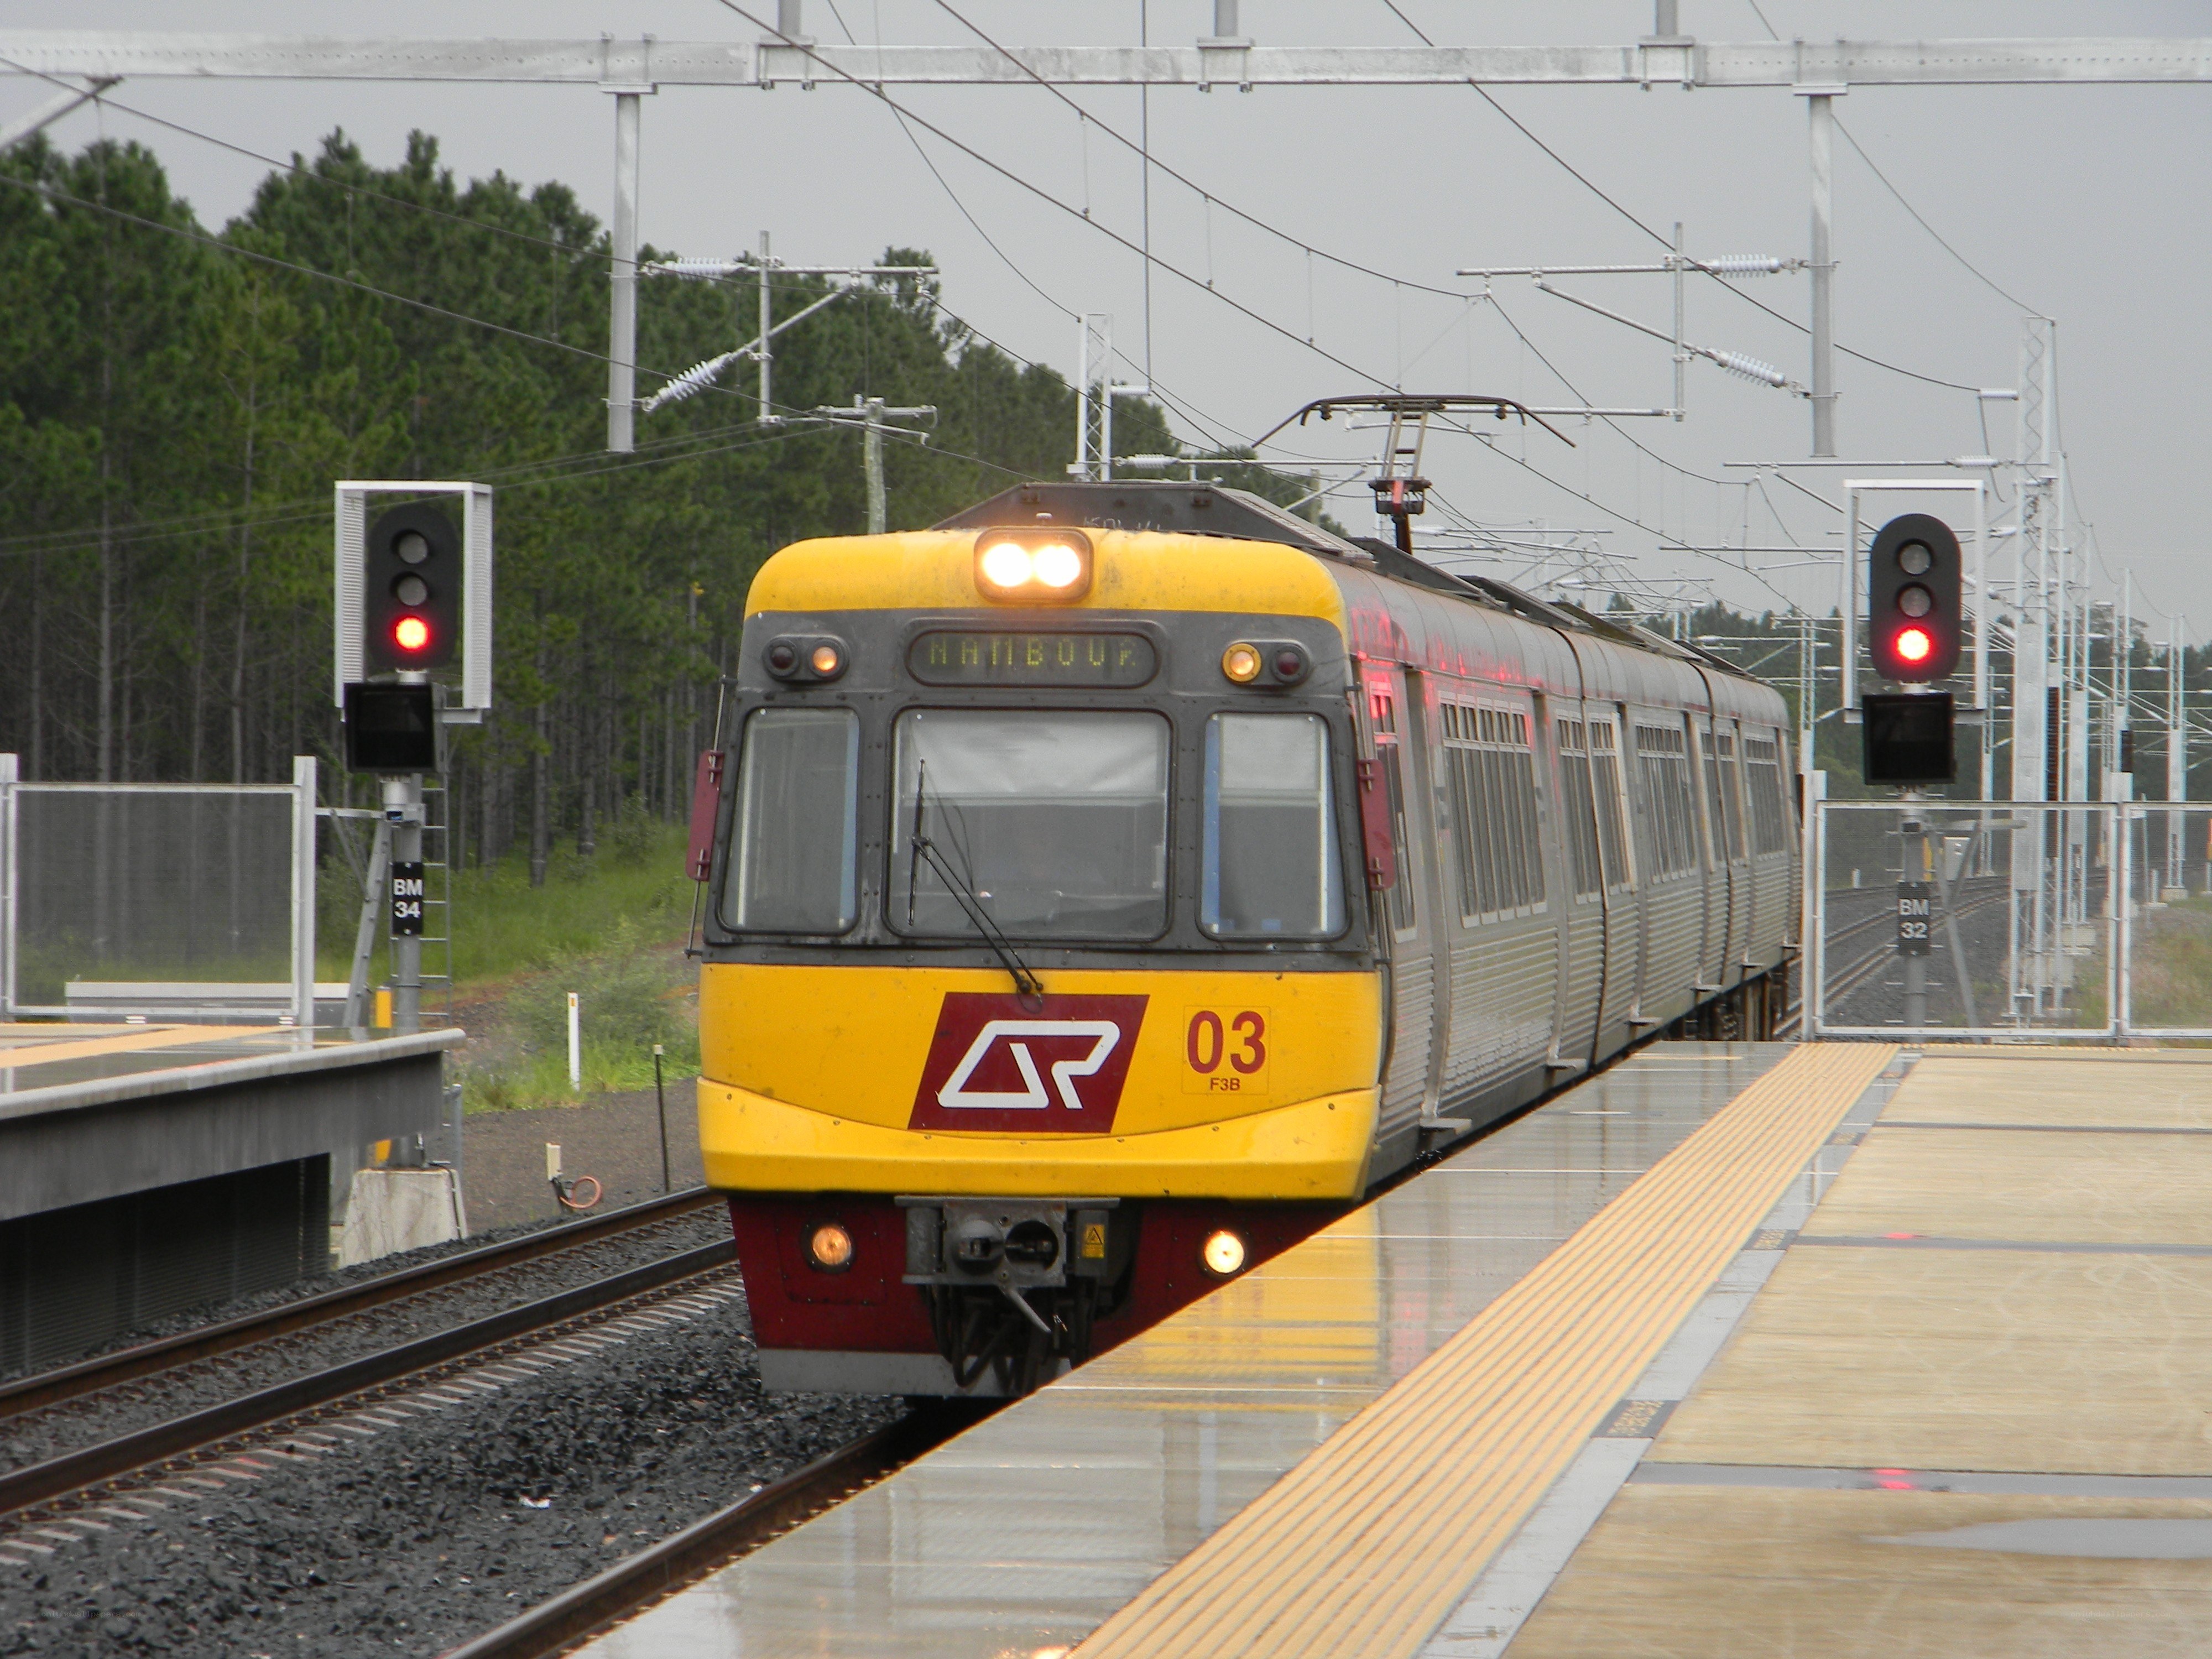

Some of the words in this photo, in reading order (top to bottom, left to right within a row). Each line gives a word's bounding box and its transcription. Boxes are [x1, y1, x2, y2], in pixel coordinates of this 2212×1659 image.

[393, 878, 422, 896] BM
[394, 901, 420, 918] 34
[1898, 898, 1929, 915] BM
[1900, 921, 1928, 938] 32
[1187, 1010, 1266, 1074] 03
[1210, 1078, 1240, 1091] F3B
